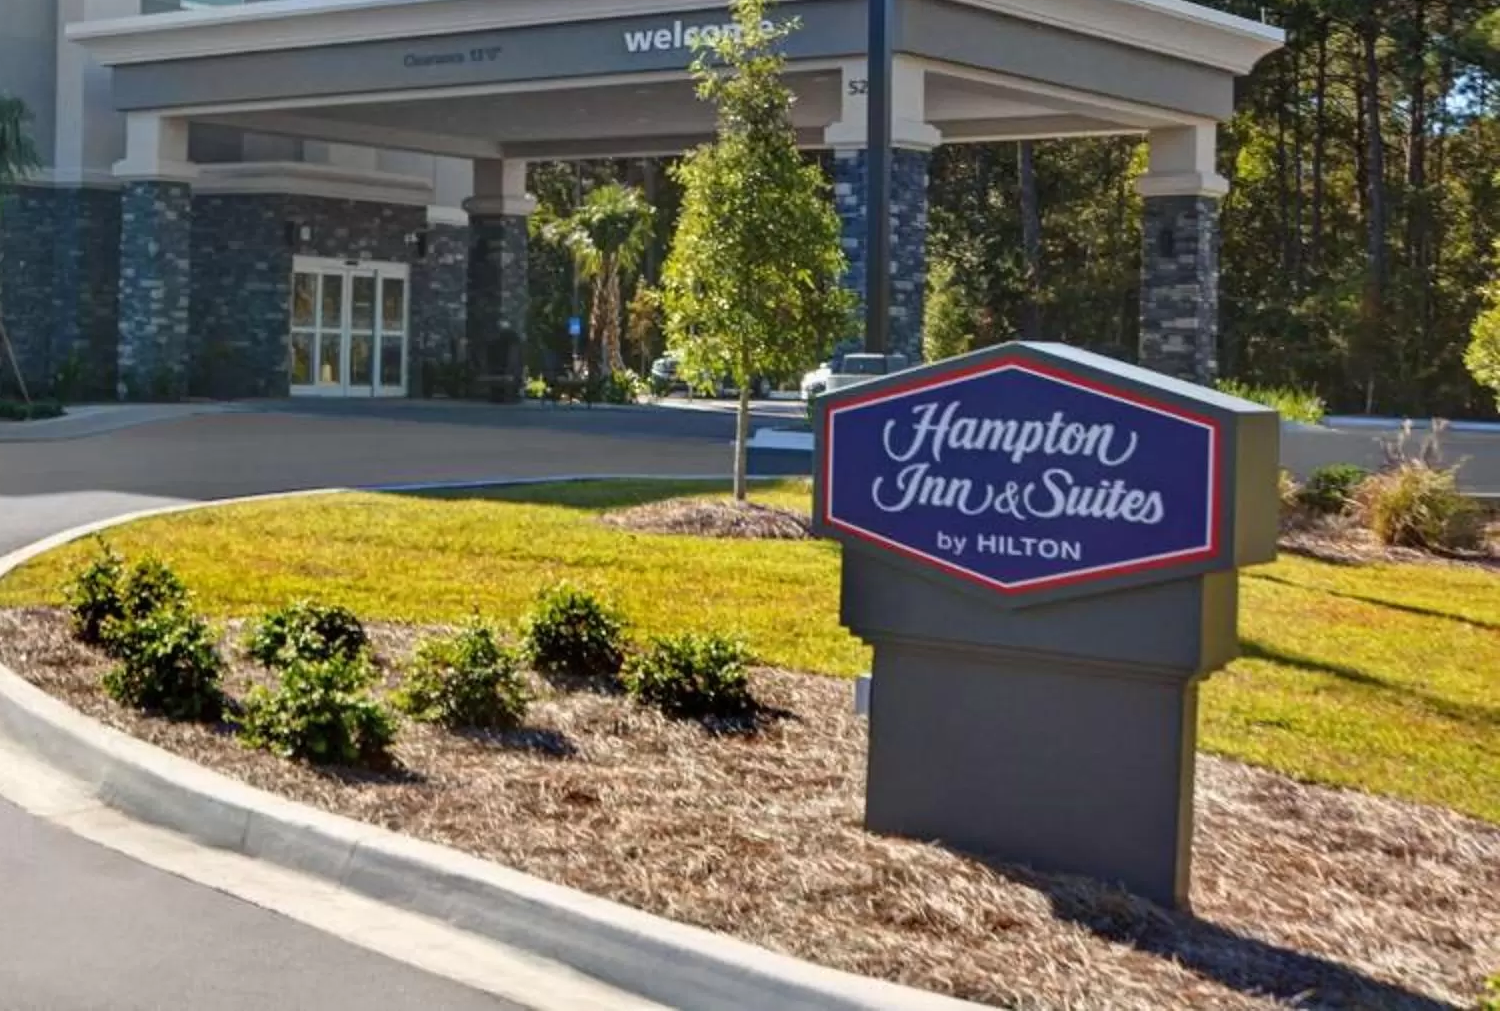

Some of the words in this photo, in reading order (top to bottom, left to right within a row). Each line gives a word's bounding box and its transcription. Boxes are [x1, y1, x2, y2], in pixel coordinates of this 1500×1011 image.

[883, 401, 1138, 467] Hampton
[872, 463, 993, 516] Inn
[994, 480, 1026, 520] &
[1023, 468, 1164, 524] Suites
[937, 530, 967, 556] by
[977, 533, 1082, 561] HILTON
